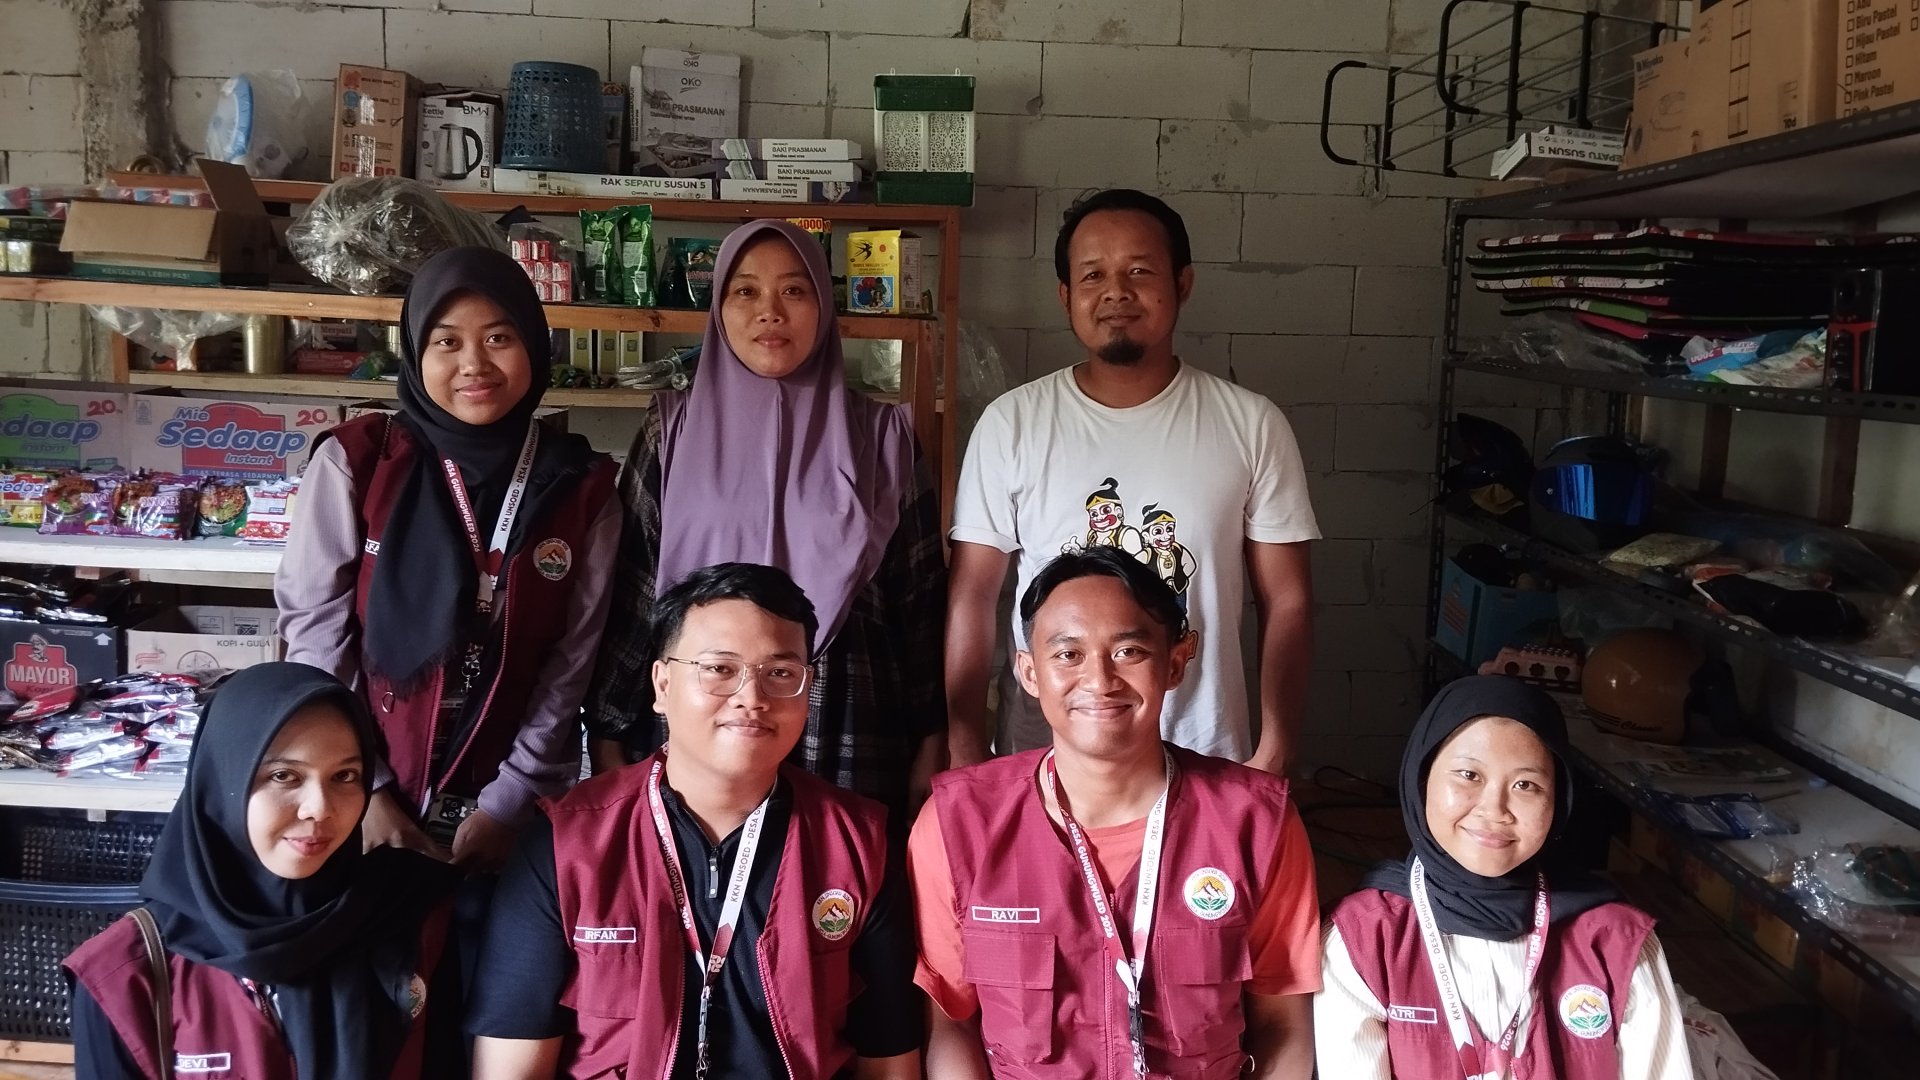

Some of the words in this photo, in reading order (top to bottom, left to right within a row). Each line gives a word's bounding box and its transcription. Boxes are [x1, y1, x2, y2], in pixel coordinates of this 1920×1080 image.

[1856, 15, 1872, 29] Biru
[1873, 3, 1897, 24] Pastel
[1855, 33, 1875, 49] Hijau
[1876, 22, 1900, 41] Pastel
[1855, 51, 1877, 66] Hitam
[681, 77, 701, 87] OKO
[1854, 68, 1881, 83] Maroon
[1853, 88, 1869, 102] Pink
[1870, 80, 1895, 98] Pastel
[423, 106, 444, 116] Kettle
[672, 103, 725, 117] PRASMANAN
[1538, 145, 1545, 154] 5
[1548, 146, 1585, 158] SUSUN
[1589, 150, 1624, 162] EPATU
[600, 177, 622, 187] RAK
[624, 179, 662, 188] SEPATU
[664, 180, 698, 189] SUSUN
[700, 181, 706, 189] 5
[148, 270, 171, 279] LEBIH
[87, 400, 116, 416] 20
[176, 406, 209, 421] Mie
[296, 408, 327, 427] 20
[0, 411, 101, 446] daap
[157, 420, 309, 457] Sedaap
[224, 453, 274, 466] Instant
[517, 466, 528, 484] DESA
[0, 480, 44, 493] edaa
[444, 459, 456, 478] DESA
[451, 478, 476, 533] GUNUNGWULED
[470, 532, 481, 552] 2026
[505, 489, 520, 517] UNSOED
[500, 517, 511, 531] KKN
[10, 665, 71, 685] MAYOR
[1150, 819, 1160, 841] DESA
[730, 887, 742, 903] KKN
[736, 847, 751, 886] UNSOED
[748, 819, 759, 839] DESA
[1143, 849, 1156, 888] UNSOED
[661, 836, 685, 905] GUNUNGWULED
[680, 904, 692, 930] 2026
[1070, 822, 1082, 847] DESA
[1077, 846, 1106, 914] GUNUNGWULED
[1100, 912, 1114, 938] 2026
[1142, 889, 1150, 905] KKN
[991, 910, 1019, 920] RAVI
[1535, 890, 1547, 927] UNSOED
[584, 930, 617, 940] IRFAN
[1428, 932, 1441, 954] DESA
[1438, 962, 1455, 1005] UNSOED
[1390, 1008, 1416, 1019] ATRI
[1450, 1006, 1461, 1021] KKN
[1500, 1029, 1515, 1051] 2026
